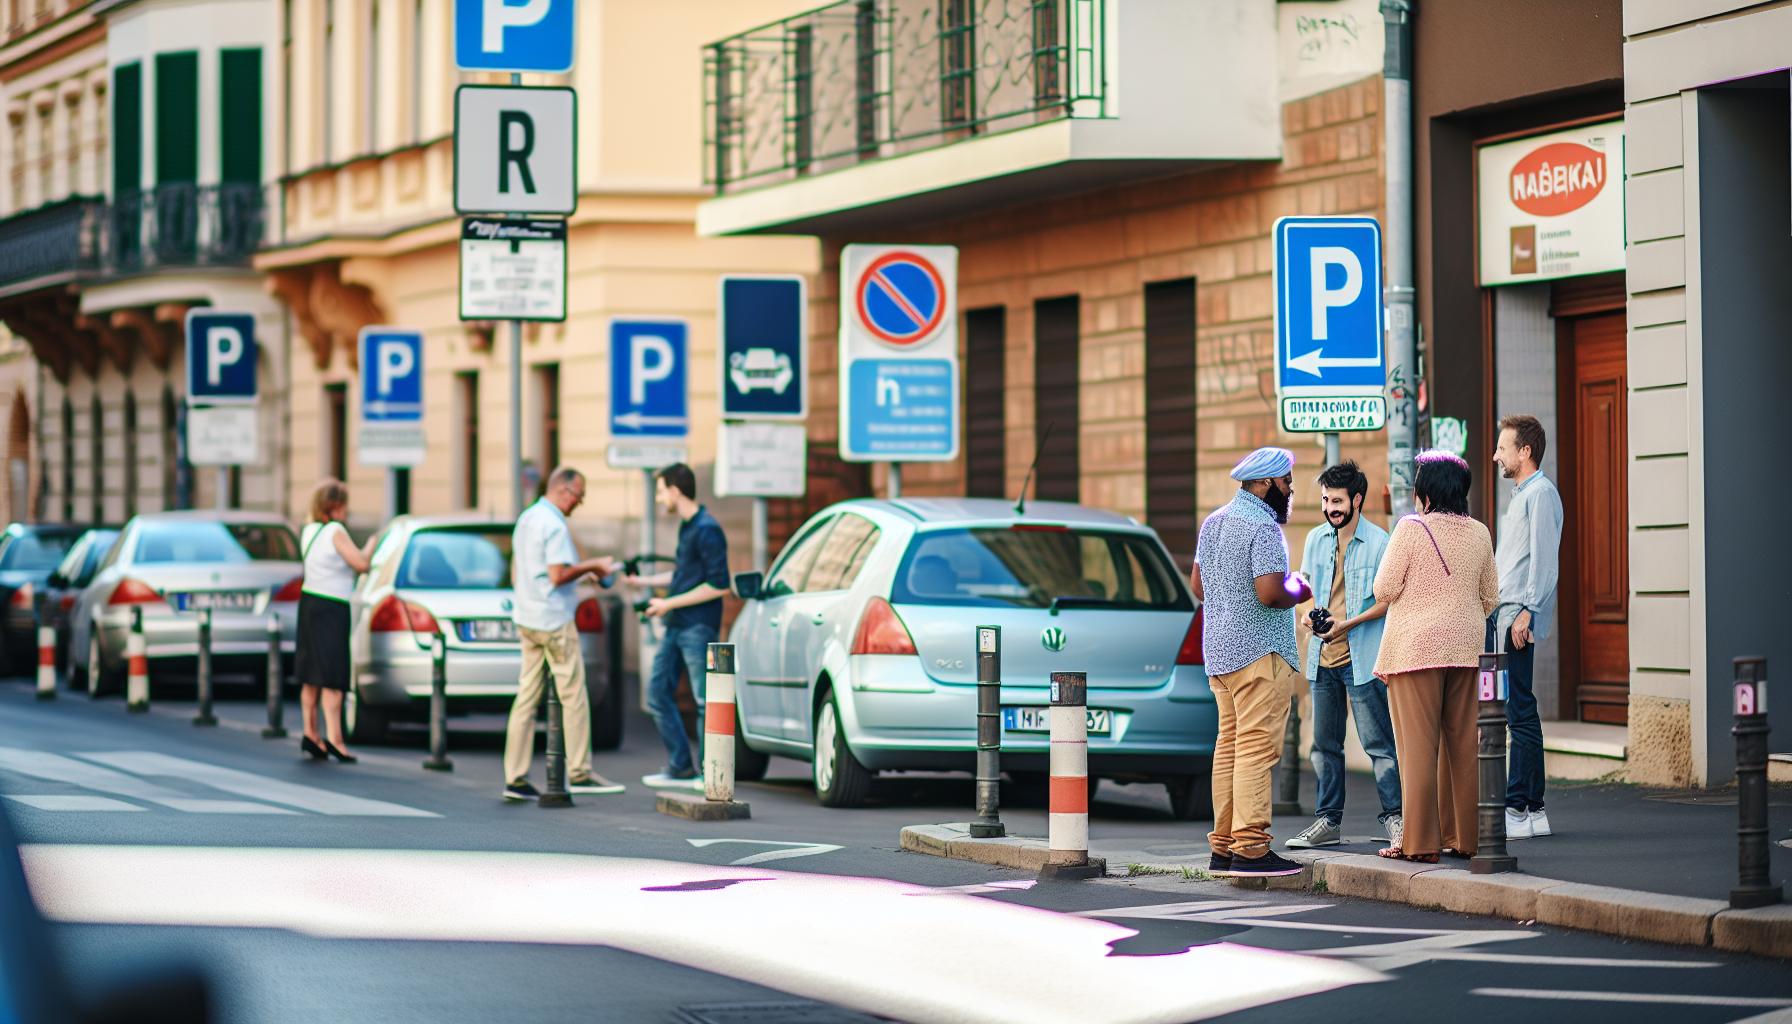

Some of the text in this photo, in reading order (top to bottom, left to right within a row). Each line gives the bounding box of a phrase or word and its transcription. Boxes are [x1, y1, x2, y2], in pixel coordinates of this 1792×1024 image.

[482, 0, 550, 53] P
[498, 109, 537, 194] R
[1309, 246, 1363, 340] P
[207, 326, 243, 386] P
[377, 341, 414, 395] P
[630, 335, 674, 405] P
